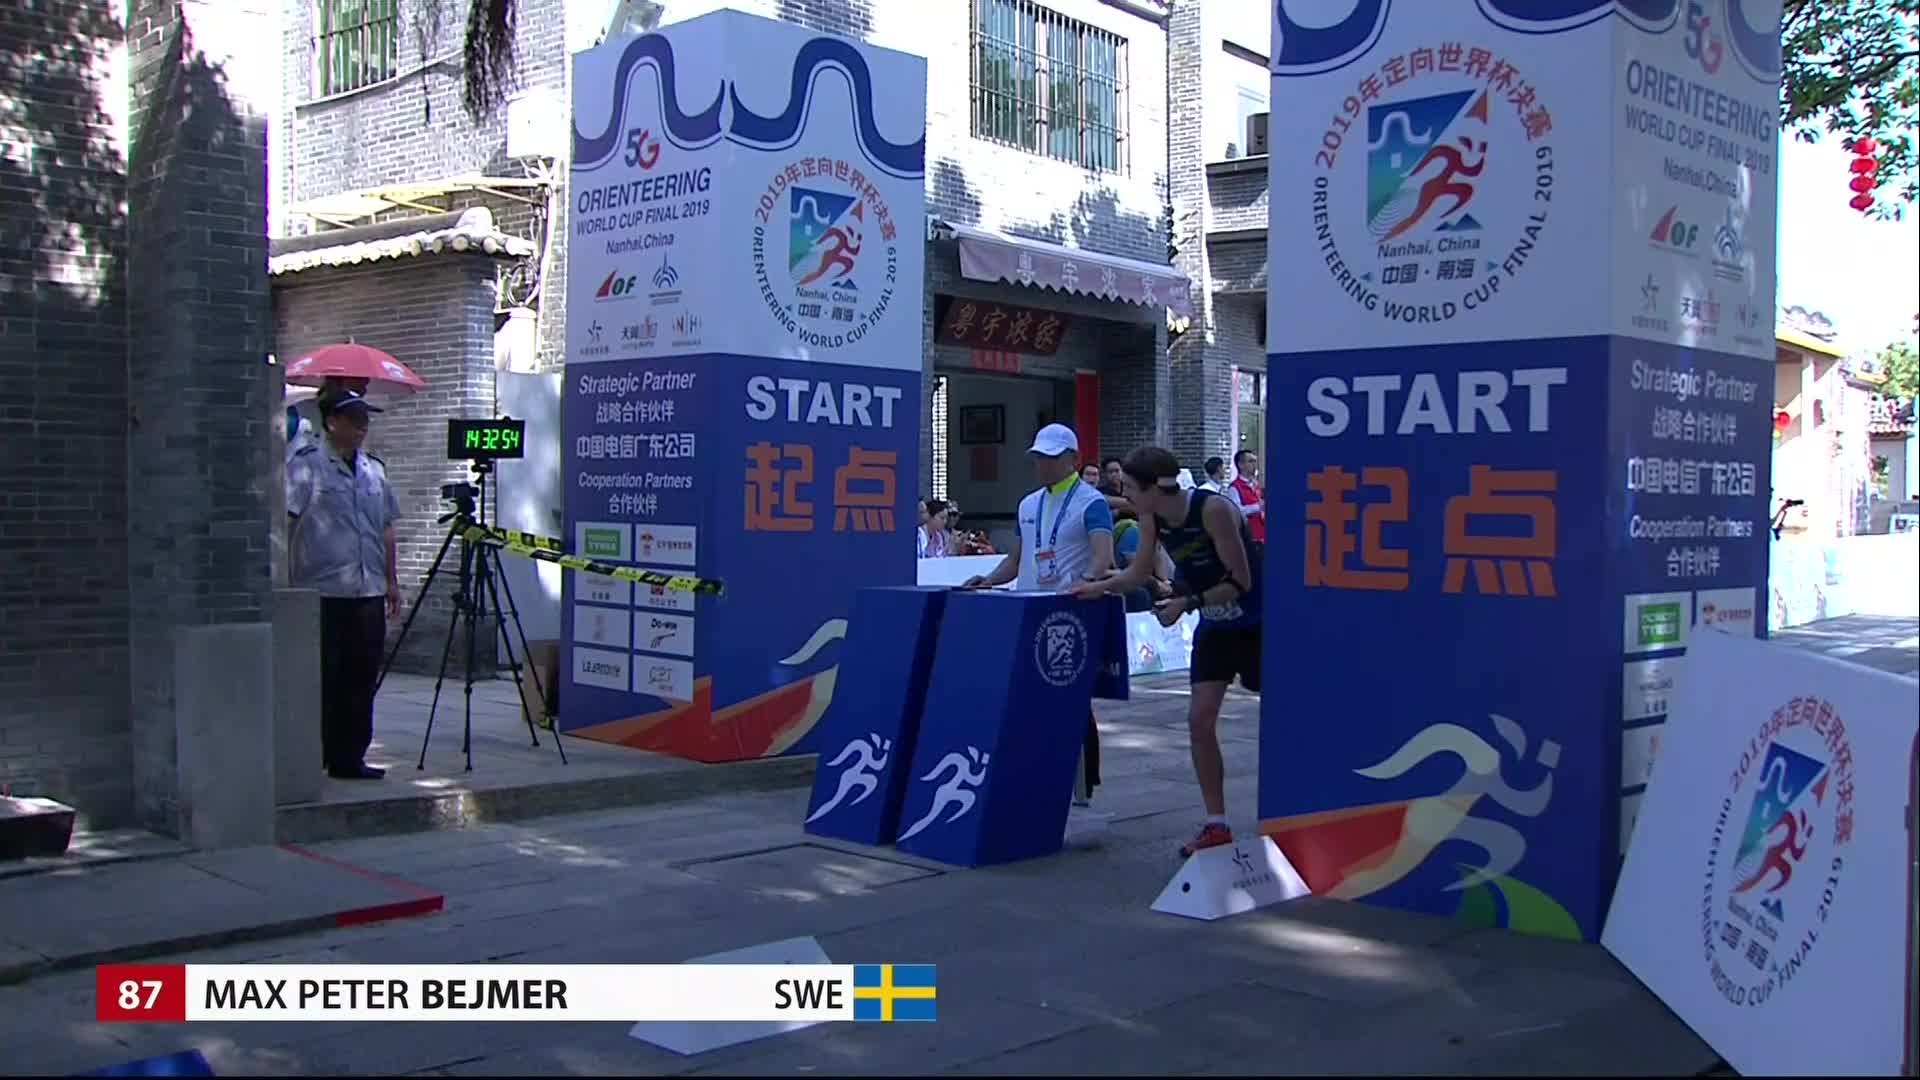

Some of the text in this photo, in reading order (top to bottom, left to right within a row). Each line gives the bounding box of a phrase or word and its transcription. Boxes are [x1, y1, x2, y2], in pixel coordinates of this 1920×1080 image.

[1315, 43, 1552, 169] 2019年定向世界杯决赛
[1627, 59, 1770, 143] ORIENTEERING
[625, 127, 660, 170] 5G
[1625, 103, 1769, 175] WORLD CUP FINAL 2019
[578, 167, 711, 214] ORIENTEERING
[755, 157, 896, 241] 2019年定向世界杯决赛
[577, 200, 710, 236] WORLD CUP FINAL 2019
[1312, 145, 1553, 323] ORIENTEERING WORLD CUP FINAL 2019
[1377, 237, 1481, 259] Nanhai, China
[753, 226, 897, 348] ORIENTEERING WORLD CUP FINAL 2019
[832, 291, 857, 304] China
[579, 370, 696, 397] Strategic Partner
[745, 375, 902, 427] START
[1305, 367, 1567, 437] START
[1631, 360, 1757, 402] Strategic Partner
[596, 399, 675, 423] 战略合作伙伴
[576, 433, 695, 459] 中国电信广东公司
[579, 471, 693, 490] Cooperation Partners
[744, 440, 897, 532] 起点
[1627, 456, 1756, 496] 中国电信广东公司
[608, 493, 658, 515] 合作伙伴
[1304, 464, 1557, 597] 起点
[1630, 515, 1753, 543] Cooperation Partners
[1667, 546, 1720, 577] 合作伙伴
[1748, 977, 1775, 1007] CUP
[1778, 929, 1819, 988] FINAL
